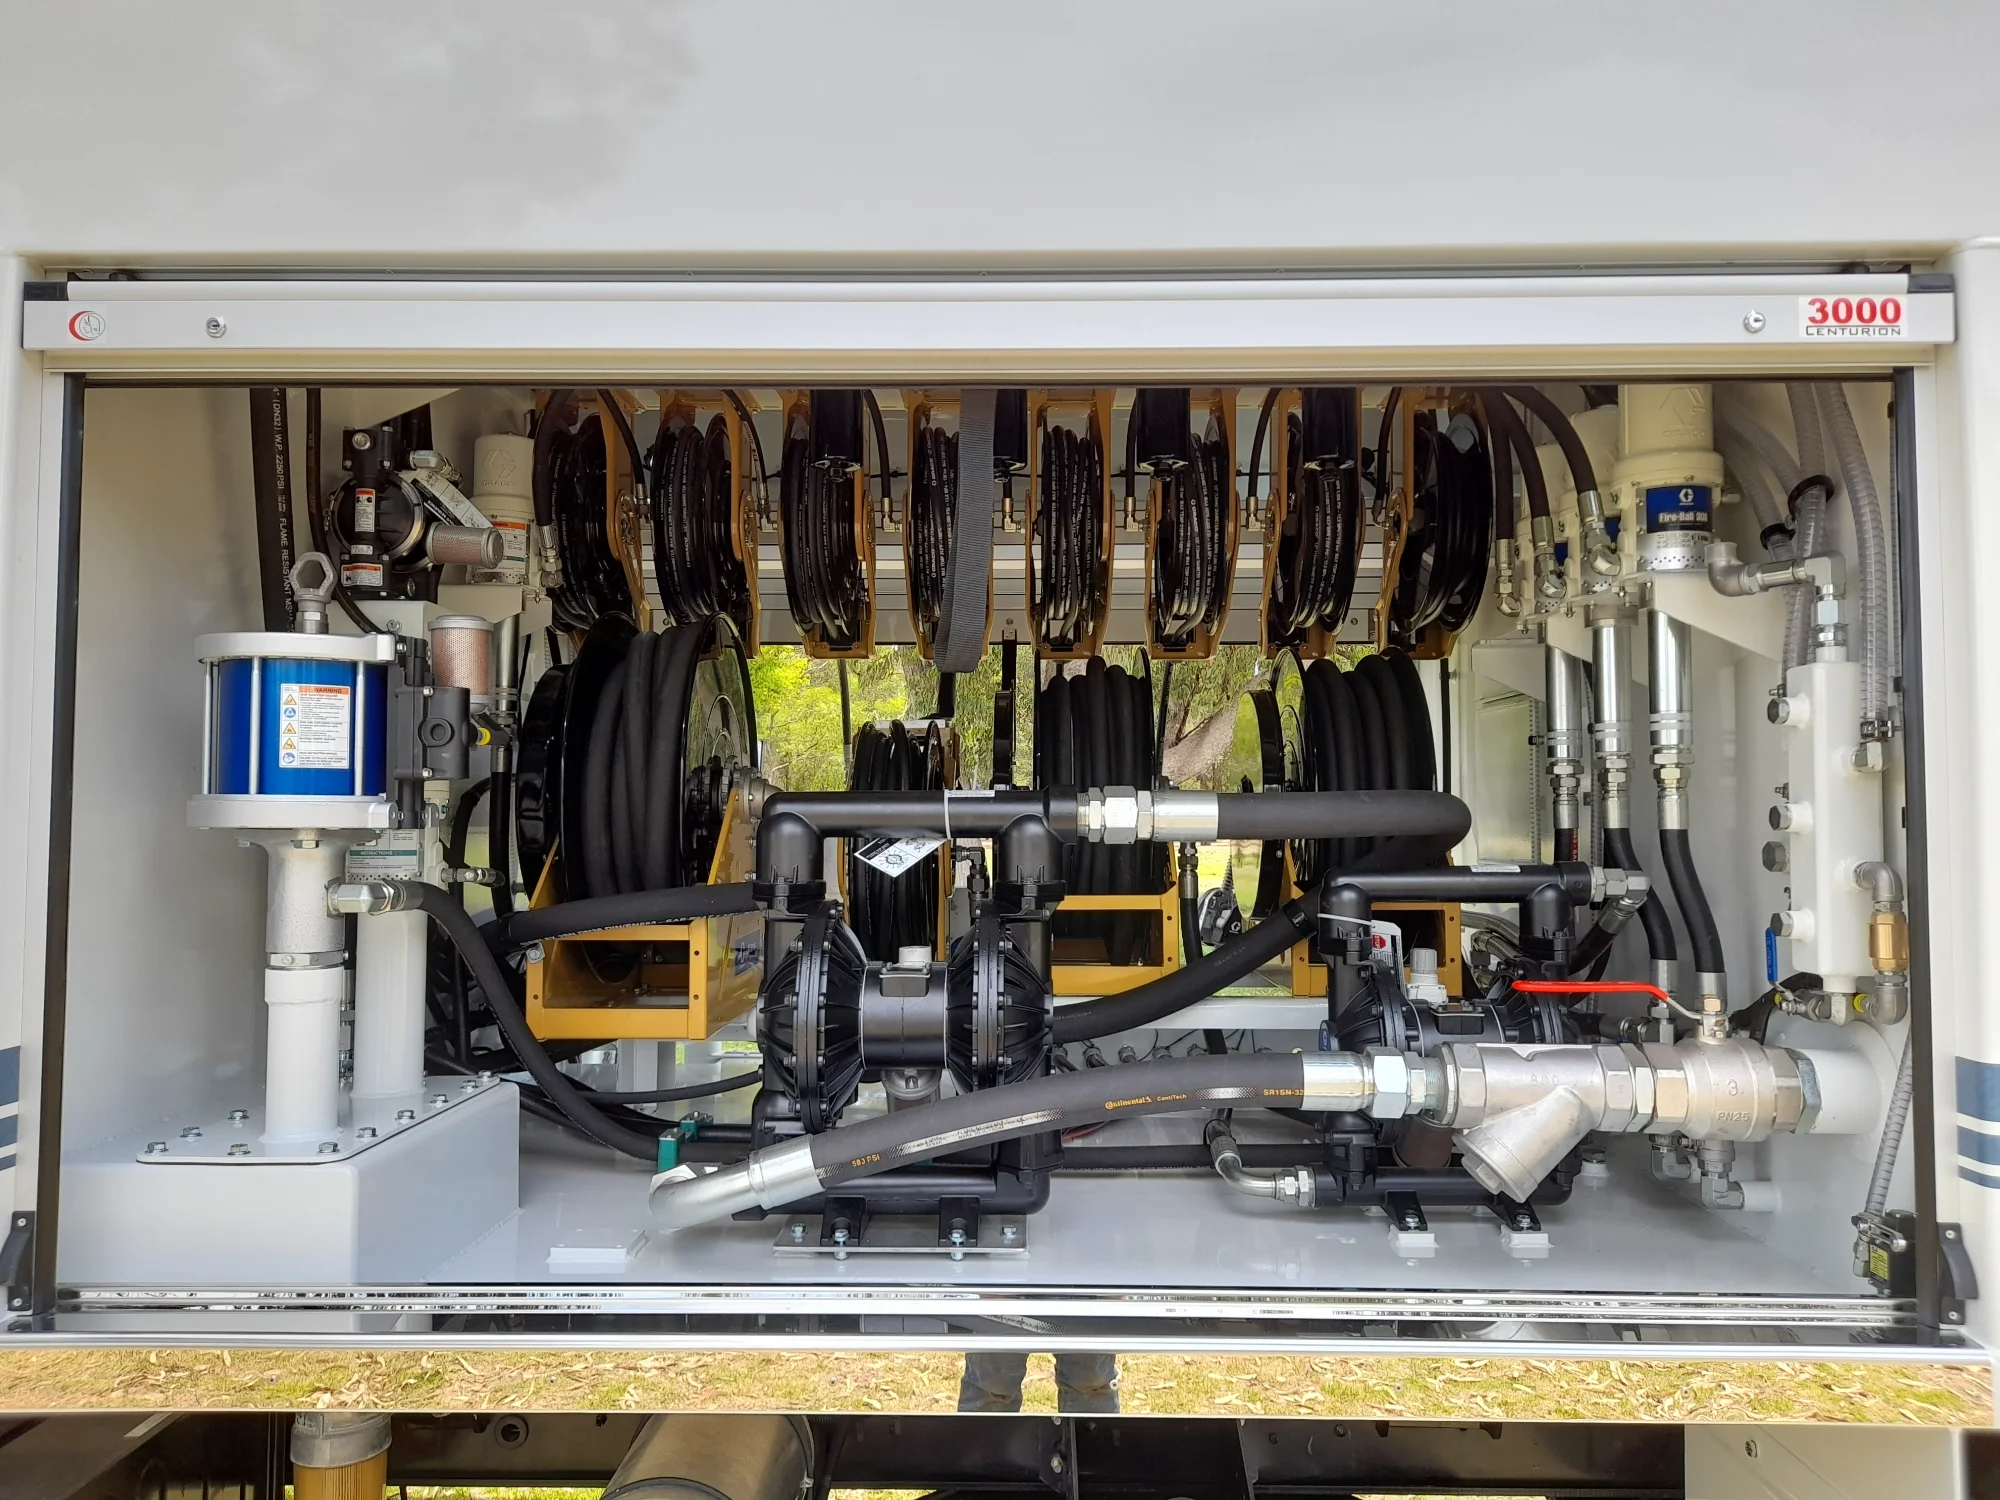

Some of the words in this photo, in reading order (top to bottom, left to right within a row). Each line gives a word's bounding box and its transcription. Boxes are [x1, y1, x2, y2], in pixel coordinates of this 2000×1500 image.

[1808, 297, 1901, 324] 3000
[1806, 325, 1901, 336] CENTURION
[272, 400, 282, 430] (DN32)
[279, 517, 289, 546] FLAME
[281, 548, 292, 595] RESISTANT
[1263, 1088, 1304, 1096] SR1SN-32
[1105, 1096, 1146, 1110] Continental
[1157, 1093, 1187, 1102] ContiTech
[1717, 1112, 1751, 1122] PN25
[867, 1153, 880, 1163] PSI
